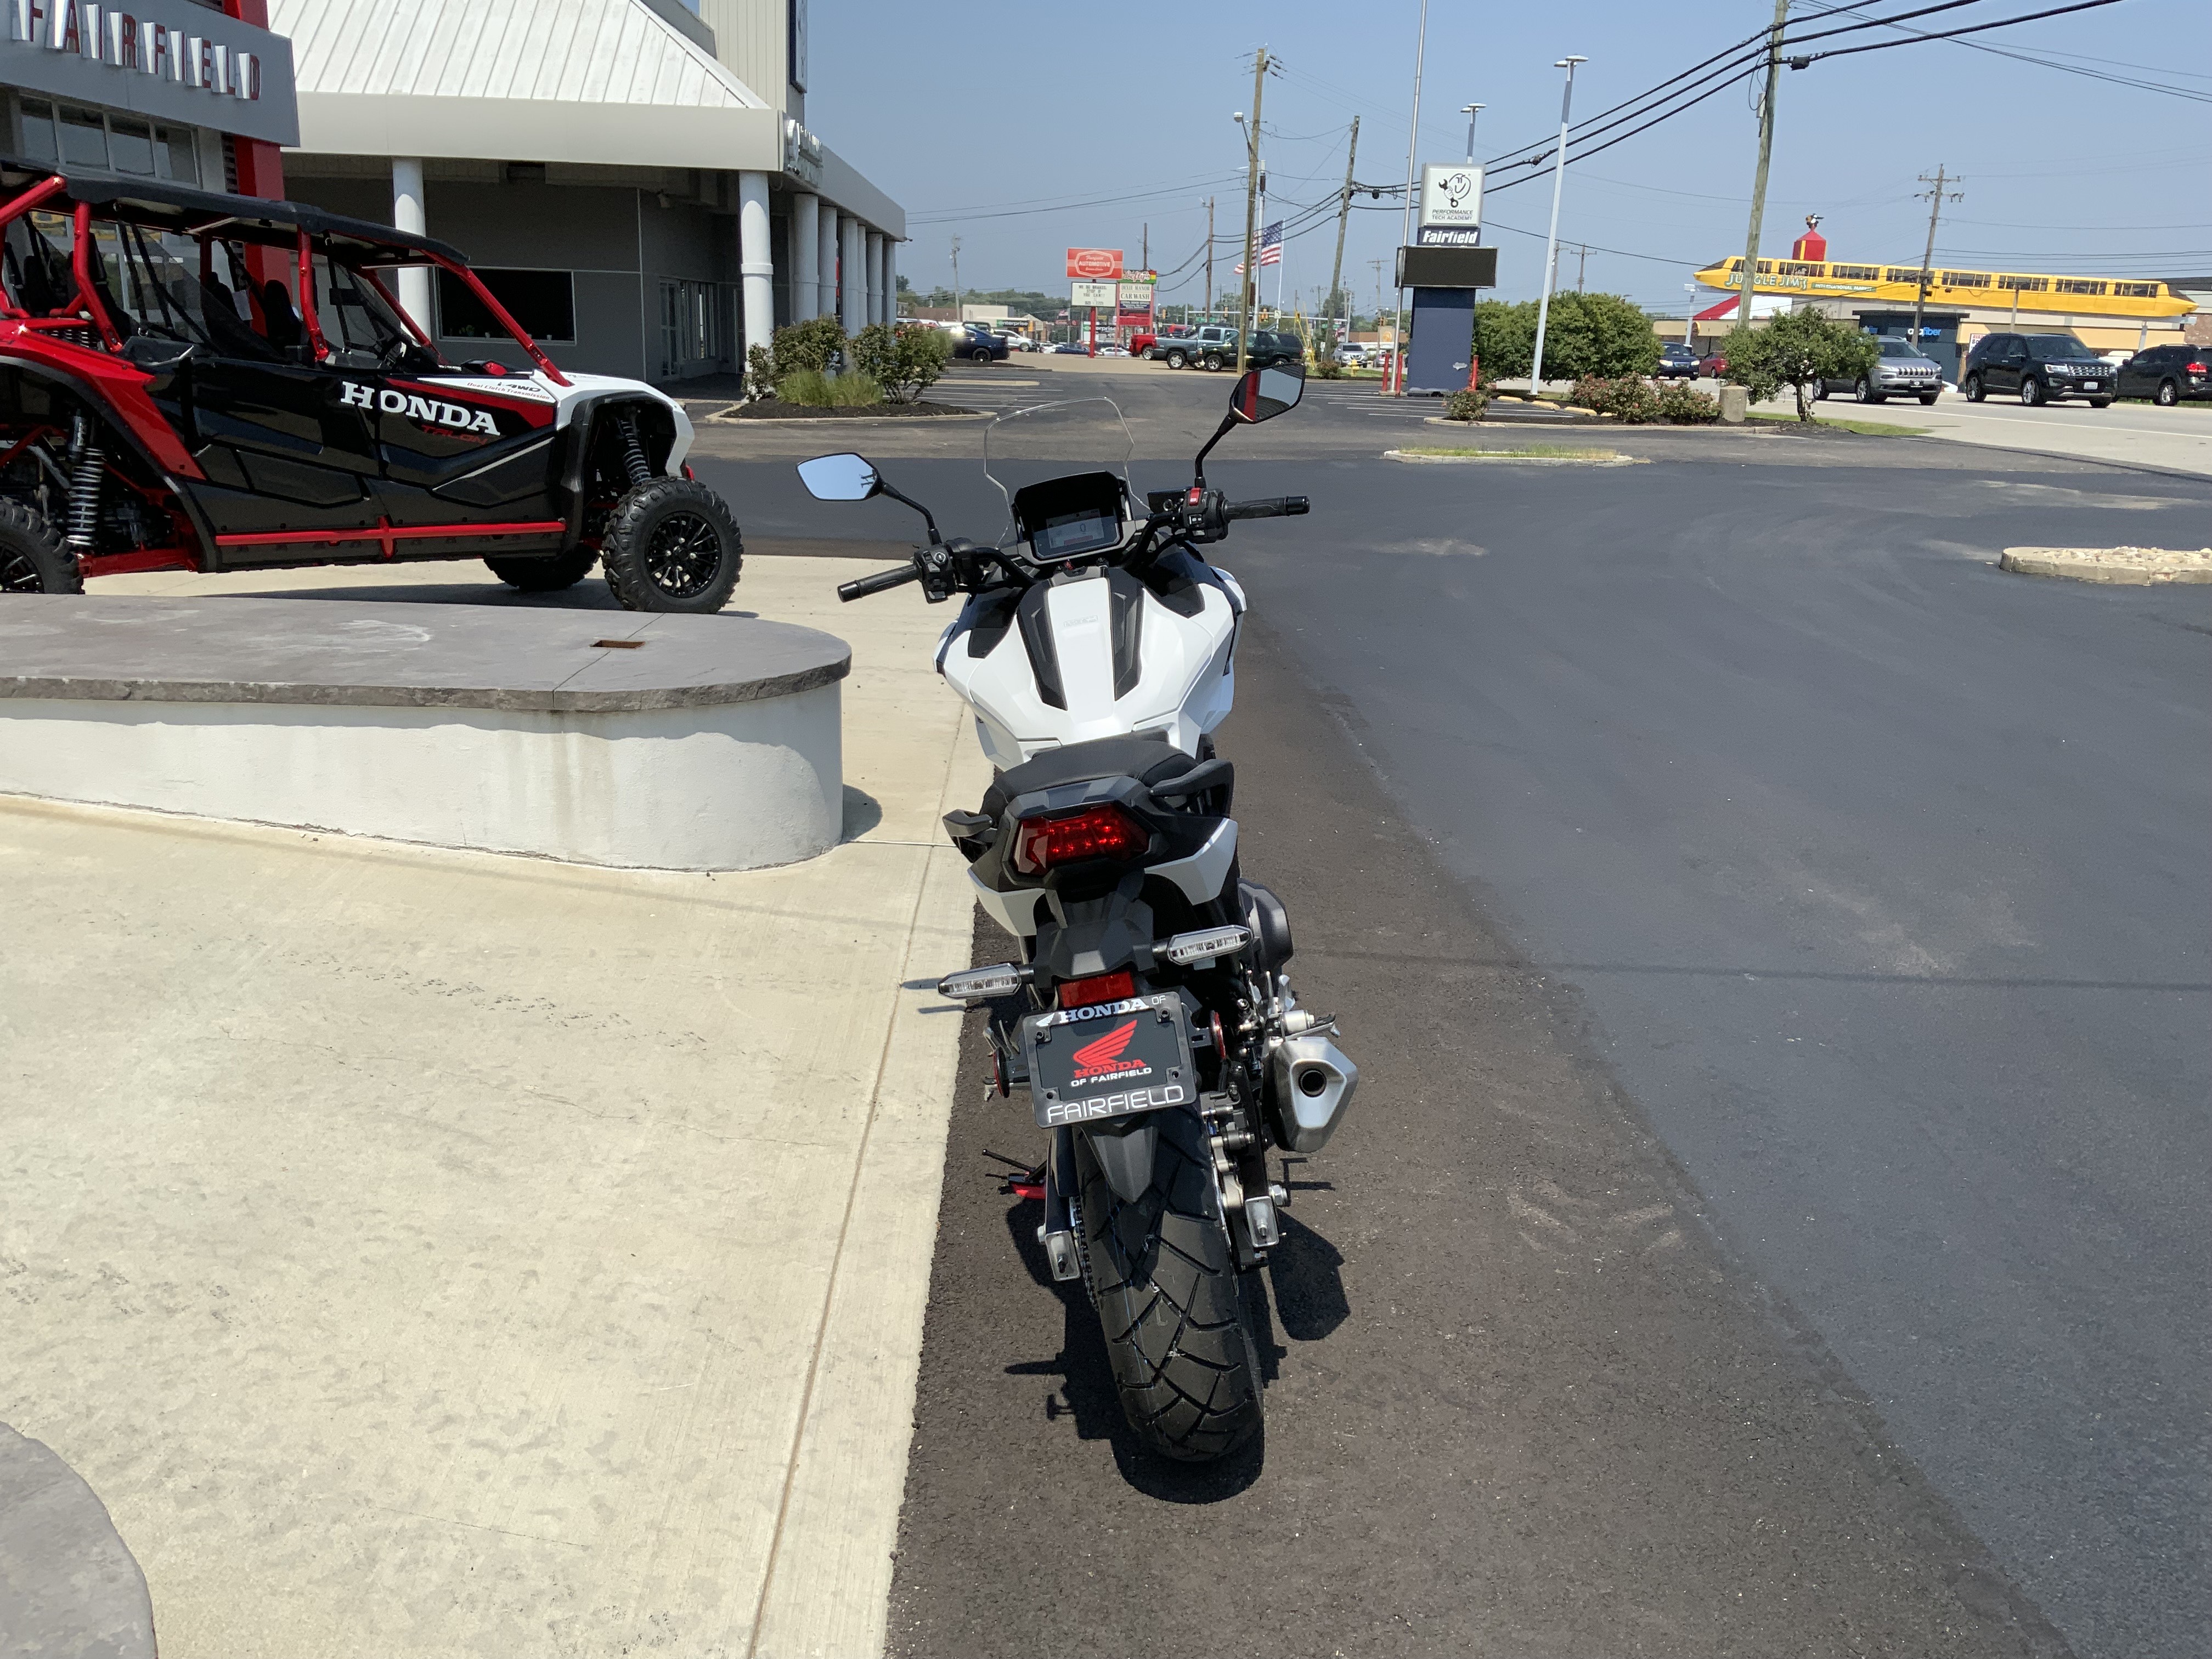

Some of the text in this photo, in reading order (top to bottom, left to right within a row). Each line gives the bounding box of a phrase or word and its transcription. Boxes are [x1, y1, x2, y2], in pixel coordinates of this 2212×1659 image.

[11, 0, 261, 101] FAIRFIELD
[1422, 230, 1478, 244] Fairfield
[1725, 273, 1808, 290] JUGLE JIM'S
[1908, 327, 1942, 337] aafiber
[506, 389, 550, 400] Transmission
[341, 381, 500, 436] HONDA
[1058, 995, 1166, 1024] HONDA OF
[1071, 1067, 1153, 1087] OF FAIRFIELD
[1074, 1059, 1147, 1079] HONDA
[1047, 1085, 1184, 1124] FAIRFIELD
